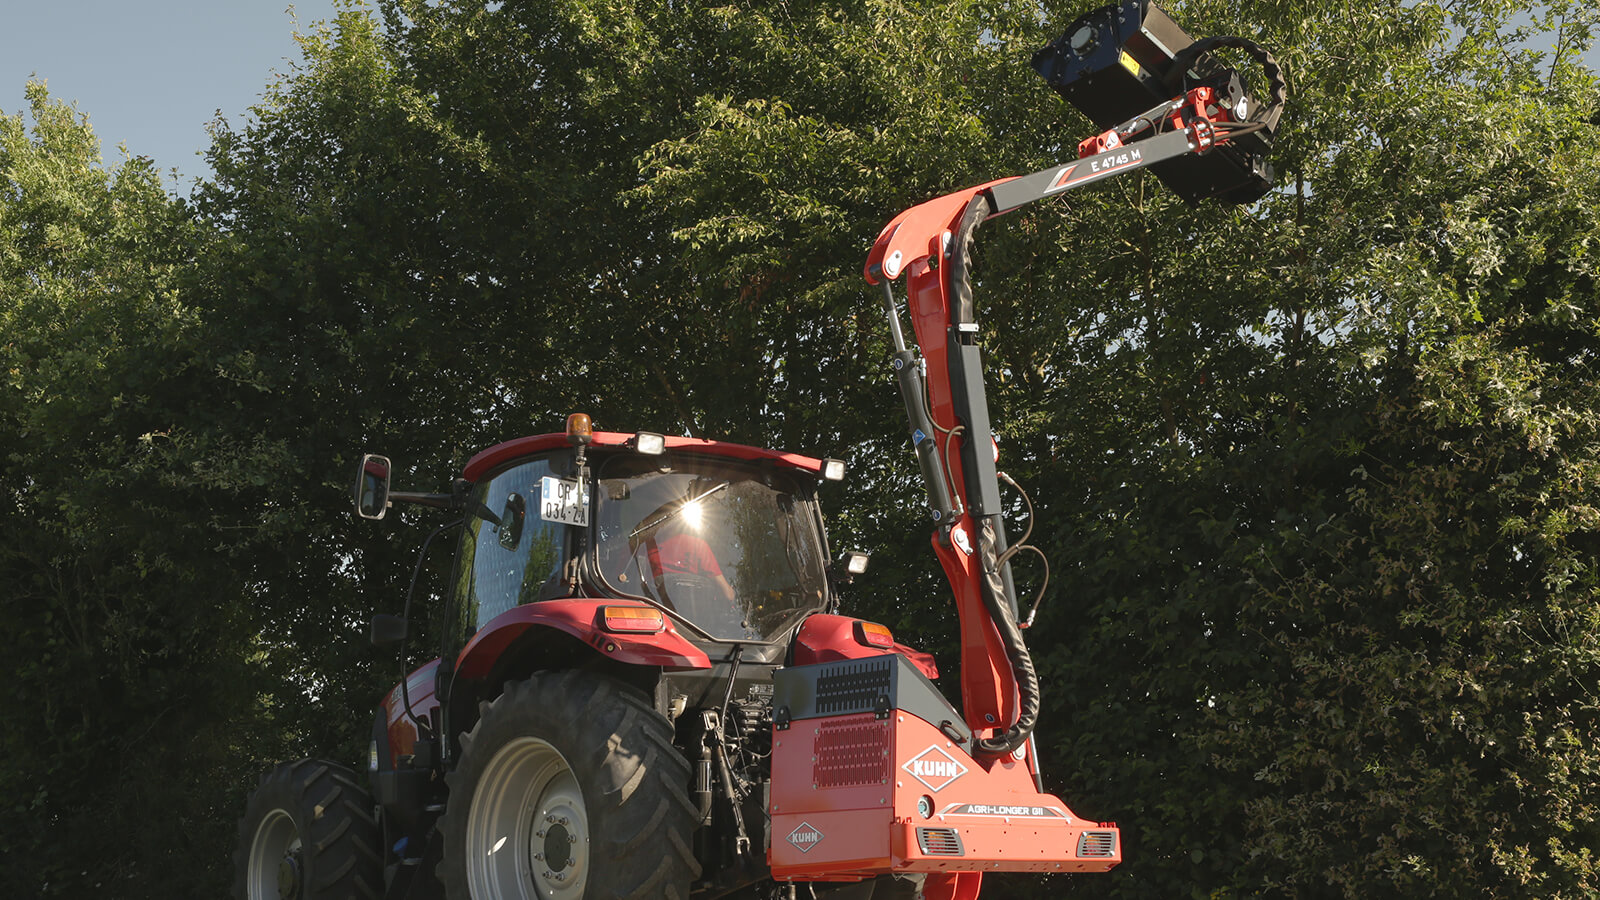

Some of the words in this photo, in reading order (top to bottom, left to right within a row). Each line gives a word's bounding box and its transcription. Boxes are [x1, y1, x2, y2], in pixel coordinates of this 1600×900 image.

[1091, 162, 1100, 172] E
[1102, 154, 1128, 168] 4745
[1131, 149, 1141, 160] M
[914, 760, 957, 776] KUHN
[967, 804, 1030, 815] AGRI-LONGER
[1032, 807, 1043, 815] GII
[792, 832, 818, 843] KUHN
